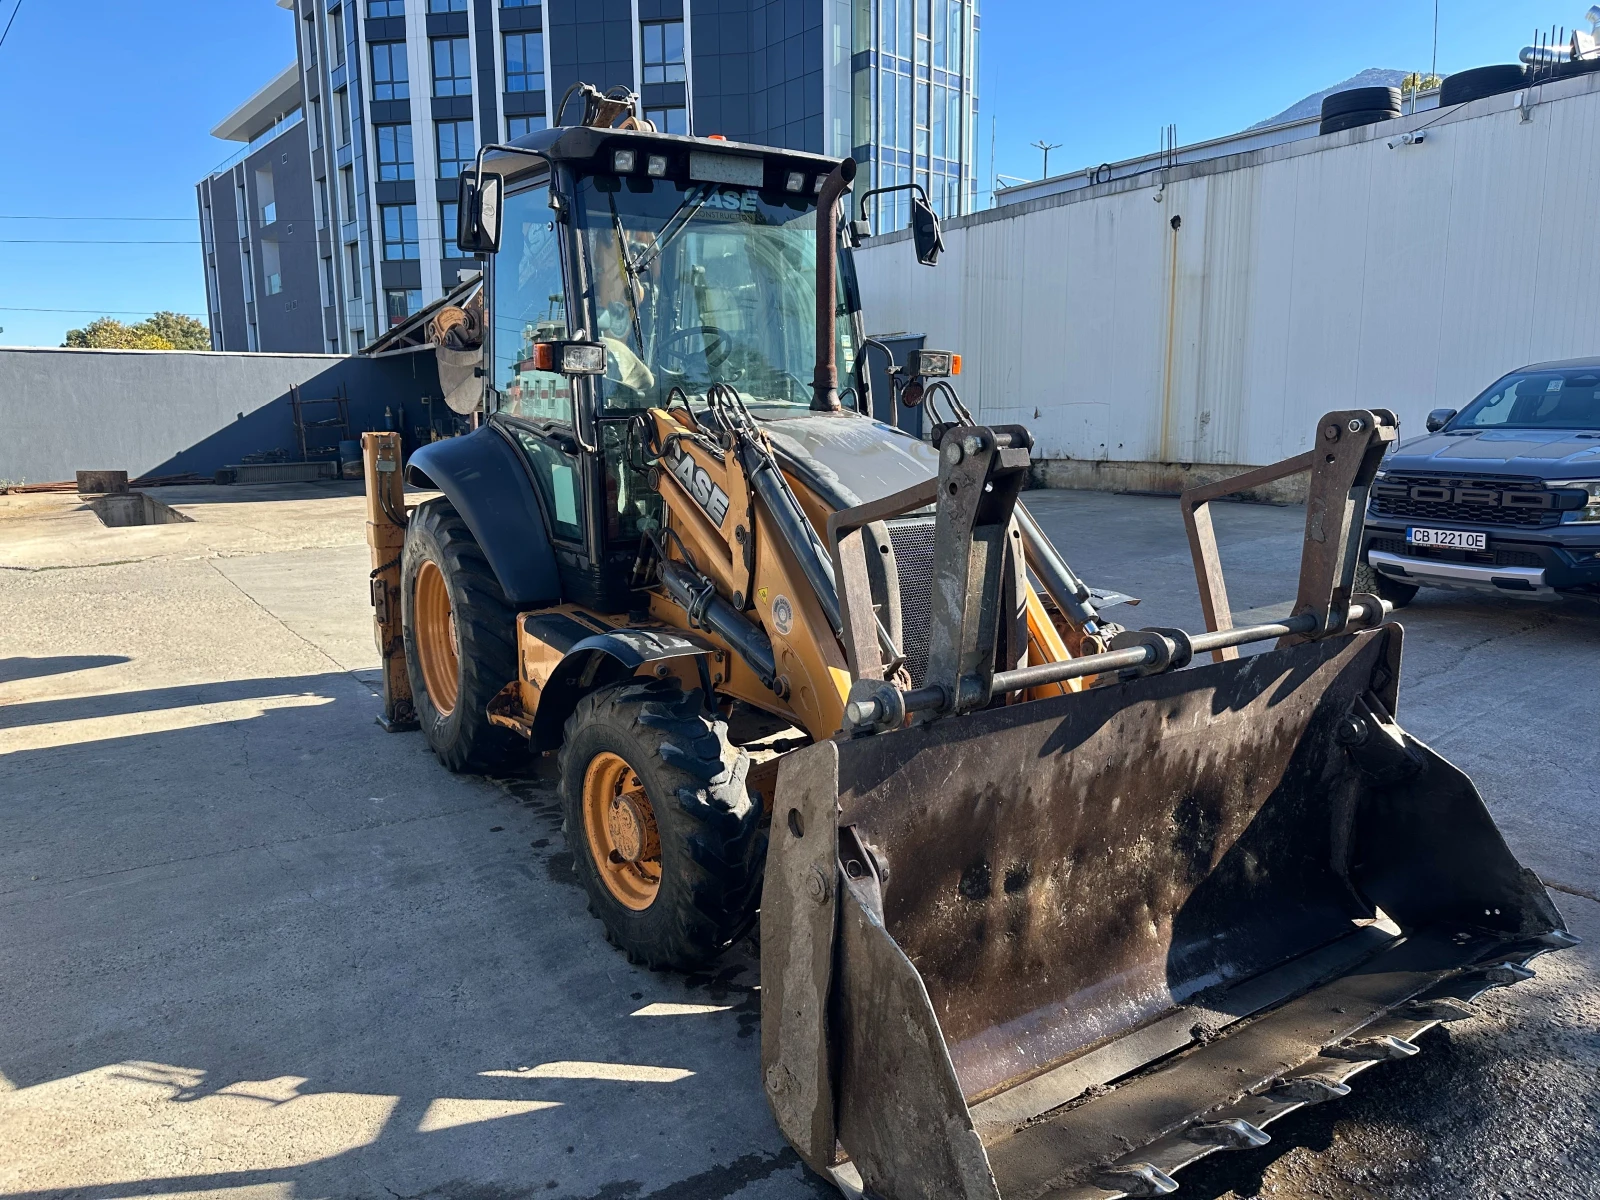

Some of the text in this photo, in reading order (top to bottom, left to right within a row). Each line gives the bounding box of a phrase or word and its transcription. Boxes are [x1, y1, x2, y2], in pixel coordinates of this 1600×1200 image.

[684, 187, 758, 212] CASE
[1372, 483, 1553, 509] FORD
[1413, 529, 1430, 543] CB
[1434, 531, 1462, 546] 1221
